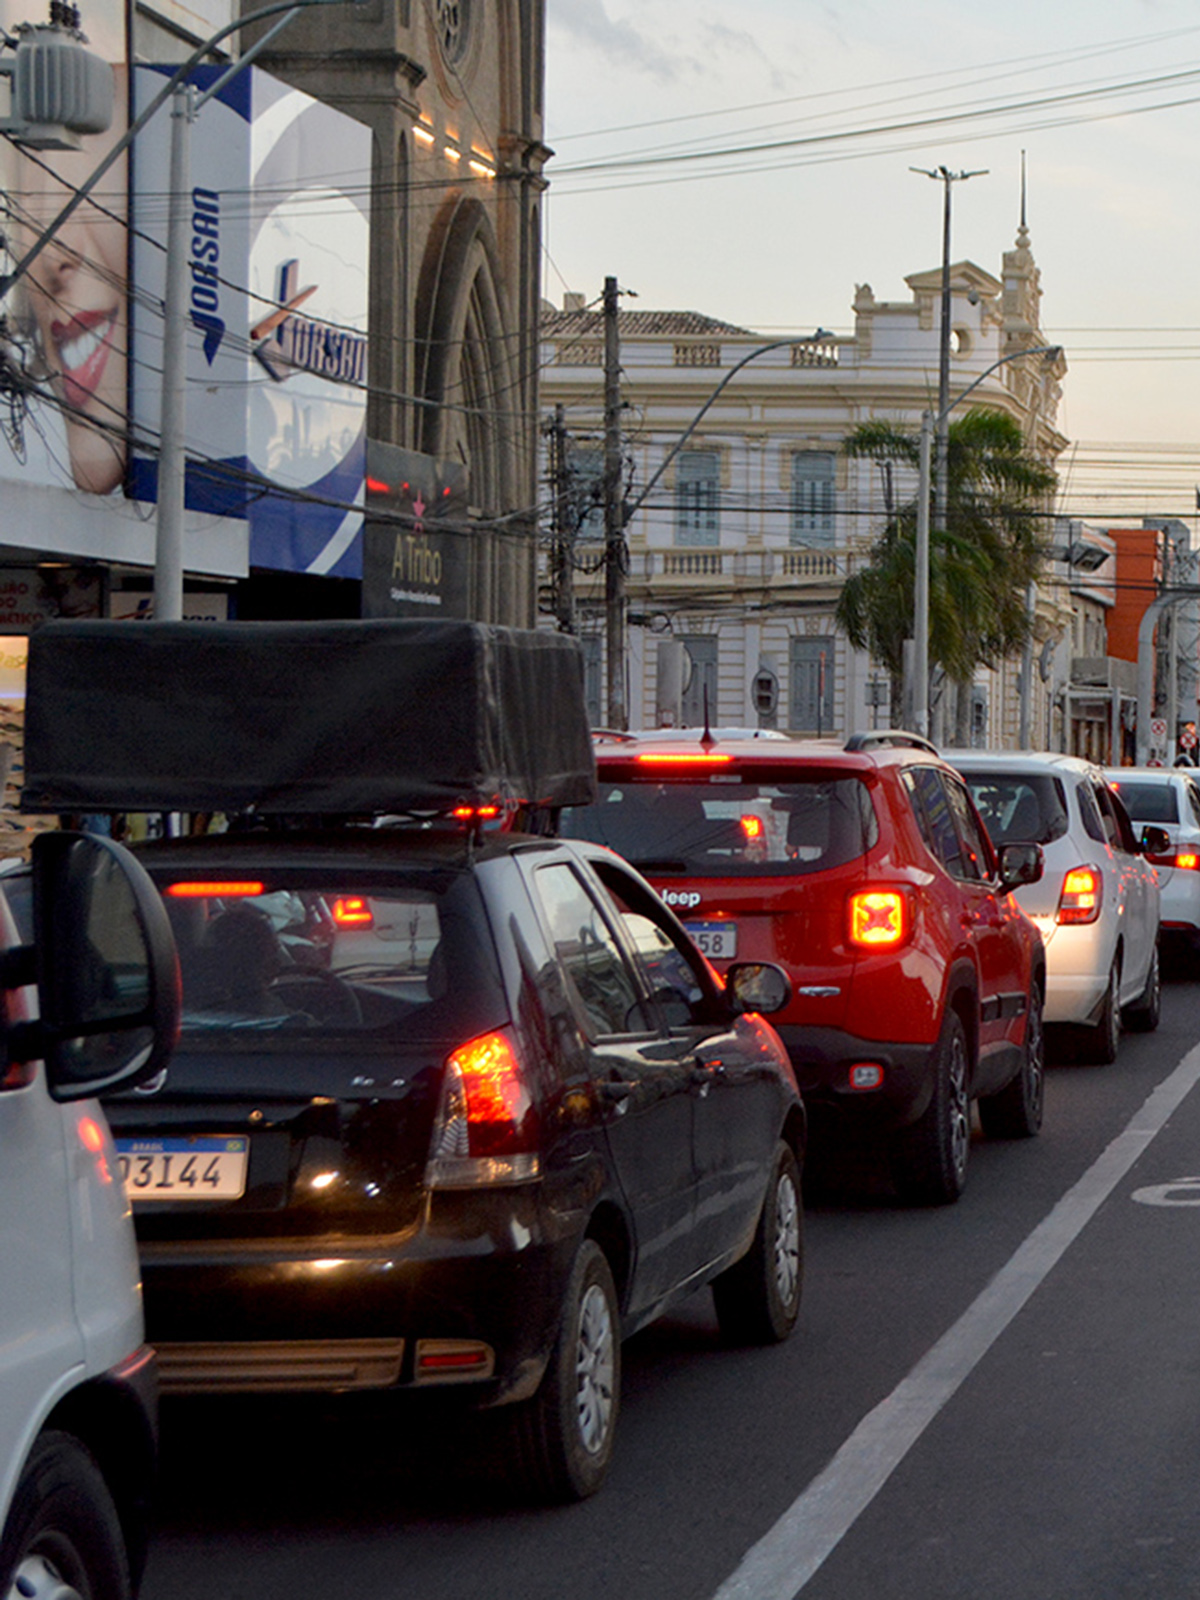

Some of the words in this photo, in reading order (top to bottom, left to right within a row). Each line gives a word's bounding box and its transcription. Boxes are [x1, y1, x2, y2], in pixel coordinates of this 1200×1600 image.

[190, 187, 226, 367] JORSAN
[405, 534, 442, 585] Tribo
[661, 889, 701, 907] Jeep
